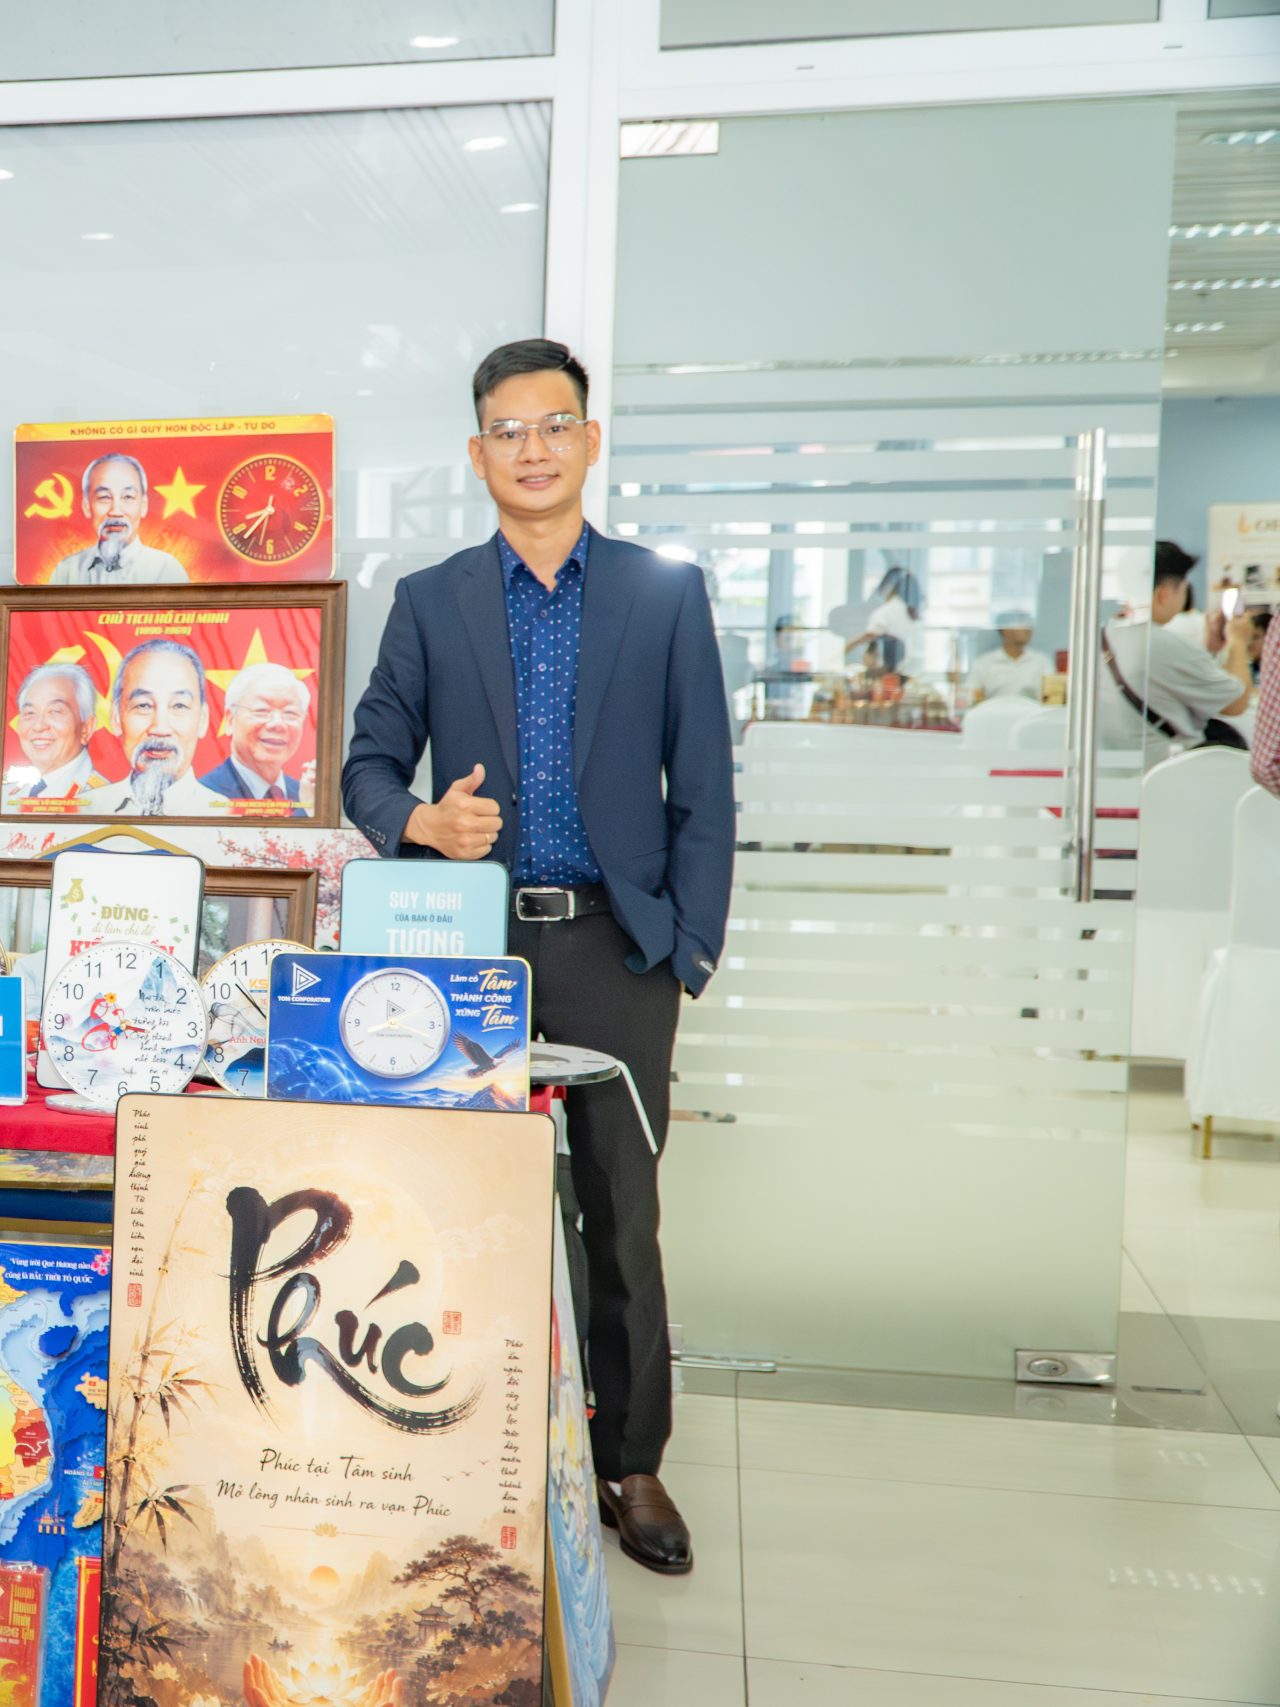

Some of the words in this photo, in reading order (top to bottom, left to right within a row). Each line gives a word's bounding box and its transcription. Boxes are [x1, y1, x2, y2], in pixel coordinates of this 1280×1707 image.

[389, 890, 419, 910] SUY
[101, 904, 150, 921] ĐỪNG
[118, 953, 137, 970] 12
[230, 960, 248, 976] 11
[84, 962, 102, 979] 11
[156, 962, 163, 978] 1
[390, 982, 400, 992] 12
[478, 968, 517, 992] Tâm
[63, 983, 84, 1000] 10
[176, 988, 187, 1004] 2
[209, 983, 231, 1000] 10
[451, 992, 482, 1002] THÀNH
[484, 992, 512, 1003] CÔNG
[54, 1013, 65, 1030] 9
[187, 1020, 198, 1037] 3
[354, 1018, 360, 1027] 9
[429, 1021, 435, 1030] 3
[64, 1045, 74, 1061] 8
[214, 1047, 225, 1063] 8
[390, 1056, 396, 1065] 6
[174, 1054, 185, 1070] 4
[87, 1069, 98, 1085] 7
[150, 1076, 161, 1092] 5
[239, 1069, 249, 1085] 7
[118, 1081, 128, 1095] 6
[217, 1187, 486, 1436] Phúc
[260, 1448, 301, 1473] Phúc
[306, 1457, 328, 1476] tại
[339, 1455, 376, 1481] Tâm
[382, 1463, 414, 1482] sinh
[217, 1479, 244, 1500] Mở
[249, 1481, 280, 1507] lòng
[285, 1489, 320, 1506] nhân
[325, 1489, 355, 1510] sinh
[359, 1500, 376, 1512] ra
[380, 1499, 406, 1515] vạn
[411, 1495, 451, 1519] Phúc
